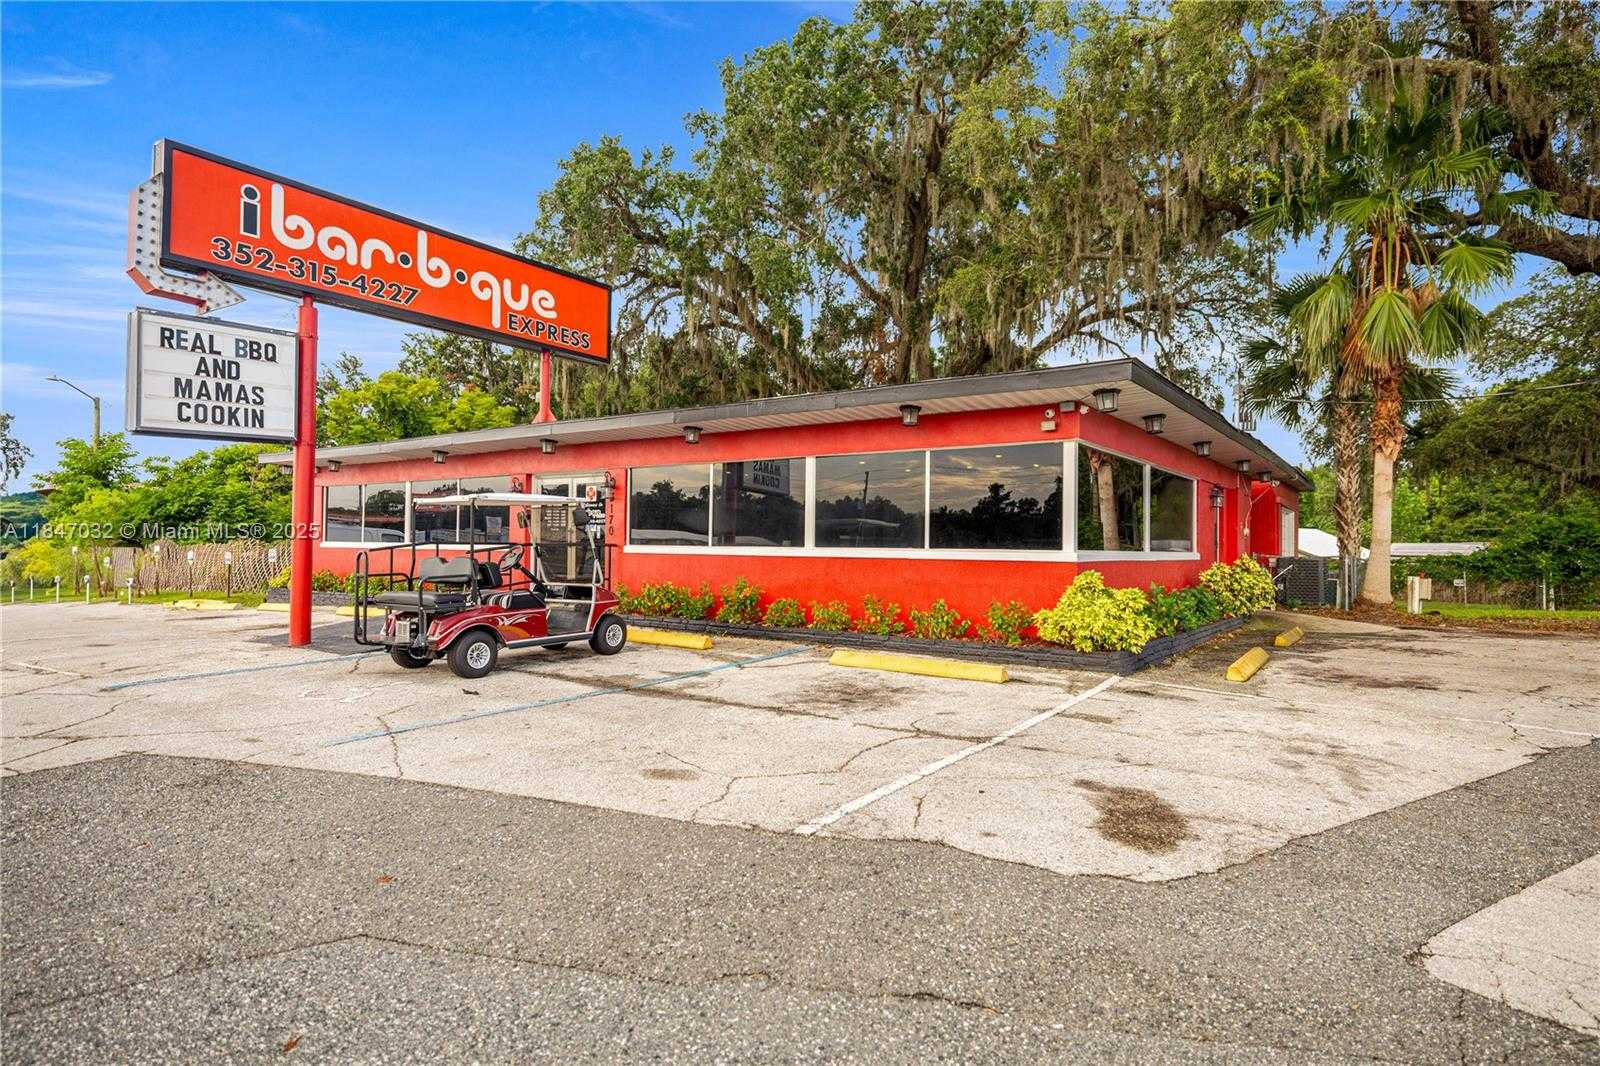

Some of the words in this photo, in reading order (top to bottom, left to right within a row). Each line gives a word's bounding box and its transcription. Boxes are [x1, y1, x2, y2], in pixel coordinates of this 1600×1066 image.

[240, 184, 261, 239] i
[211, 236, 420, 305] 352-315-4227
[160, 326, 222, 356] REAL
[234, 337, 280, 364] BBQ
[507, 312, 592, 350] EXPRESS
[194, 356, 241, 381] AND
[173, 377, 265, 406] MAMAS
[176, 401, 265, 429] COOKIN
